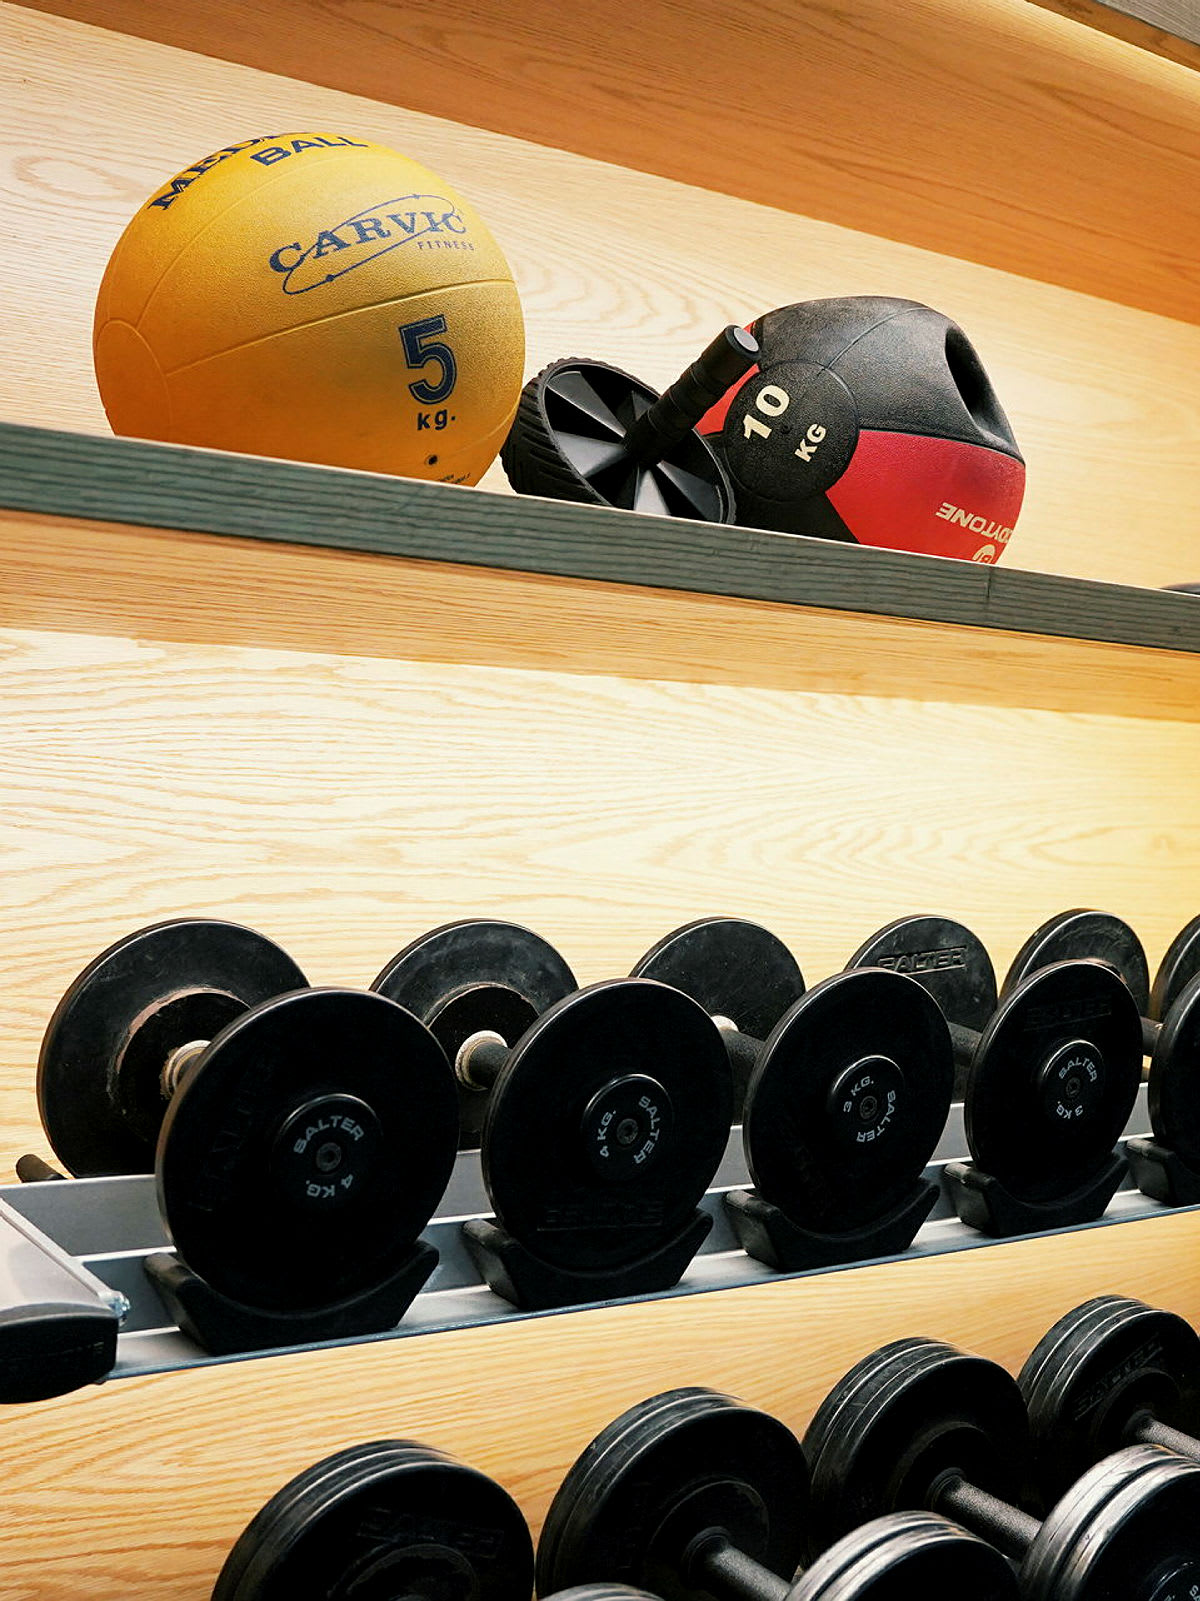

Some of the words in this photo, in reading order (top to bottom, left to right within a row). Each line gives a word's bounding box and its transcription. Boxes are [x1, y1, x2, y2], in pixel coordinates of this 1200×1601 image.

[249, 136, 369, 167] BALL
[269, 211, 467, 273] CARVIC
[417, 241, 476, 251] FITNESS
[398, 313, 458, 405] 5
[417, 409, 456, 431] kg.
[742, 384, 790, 440] 10
[794, 423, 827, 462] KG
[1059, 1057, 1098, 1082] SALTER
[843, 1101, 852, 1113] 3
[856, 1090, 896, 1142] SALTER
[1075, 1104, 1084, 1117] 3
[293, 1115, 364, 1154] SALTER
[597, 1110, 617, 1141] KG.
[633, 1096, 660, 1164] SALTER
[600, 1145, 610, 1158] 4
[305, 1180, 336, 1198] KG.
[341, 1174, 354, 1189] 4
